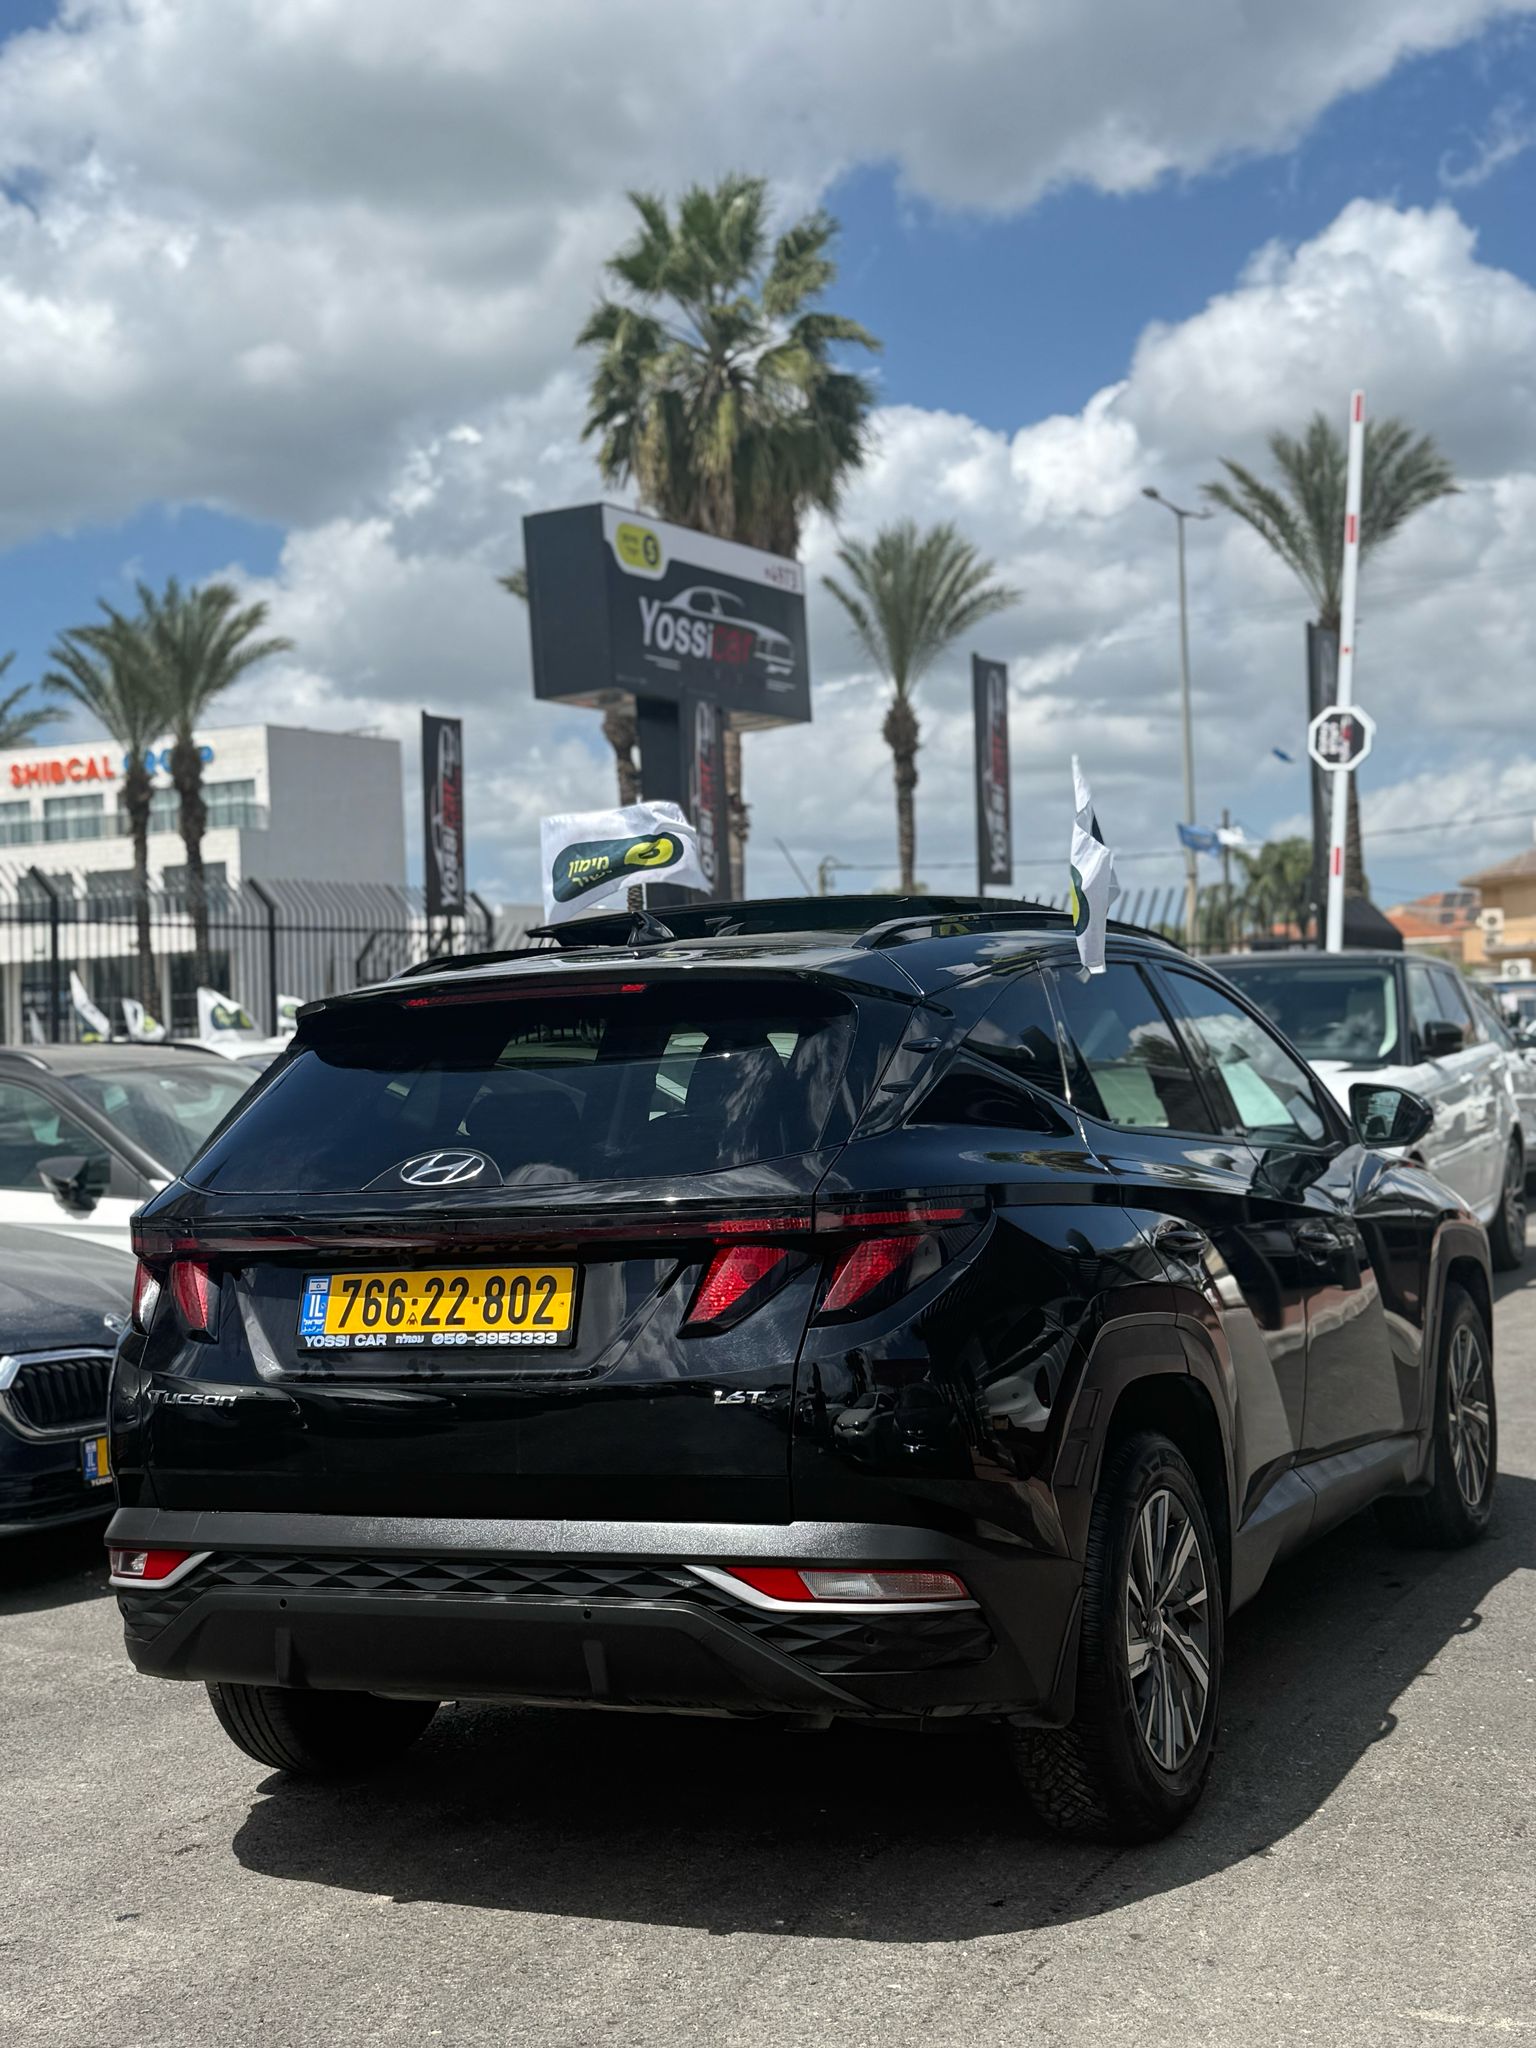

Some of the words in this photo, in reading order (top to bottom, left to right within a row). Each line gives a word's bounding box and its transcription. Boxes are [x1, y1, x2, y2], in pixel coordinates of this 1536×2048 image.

[567, 855, 609, 878] מימון
[309, 1294, 323, 1317] IL
[305, 1333, 349, 1347] YOSSI
[354, 1333, 387, 1346] CAR
